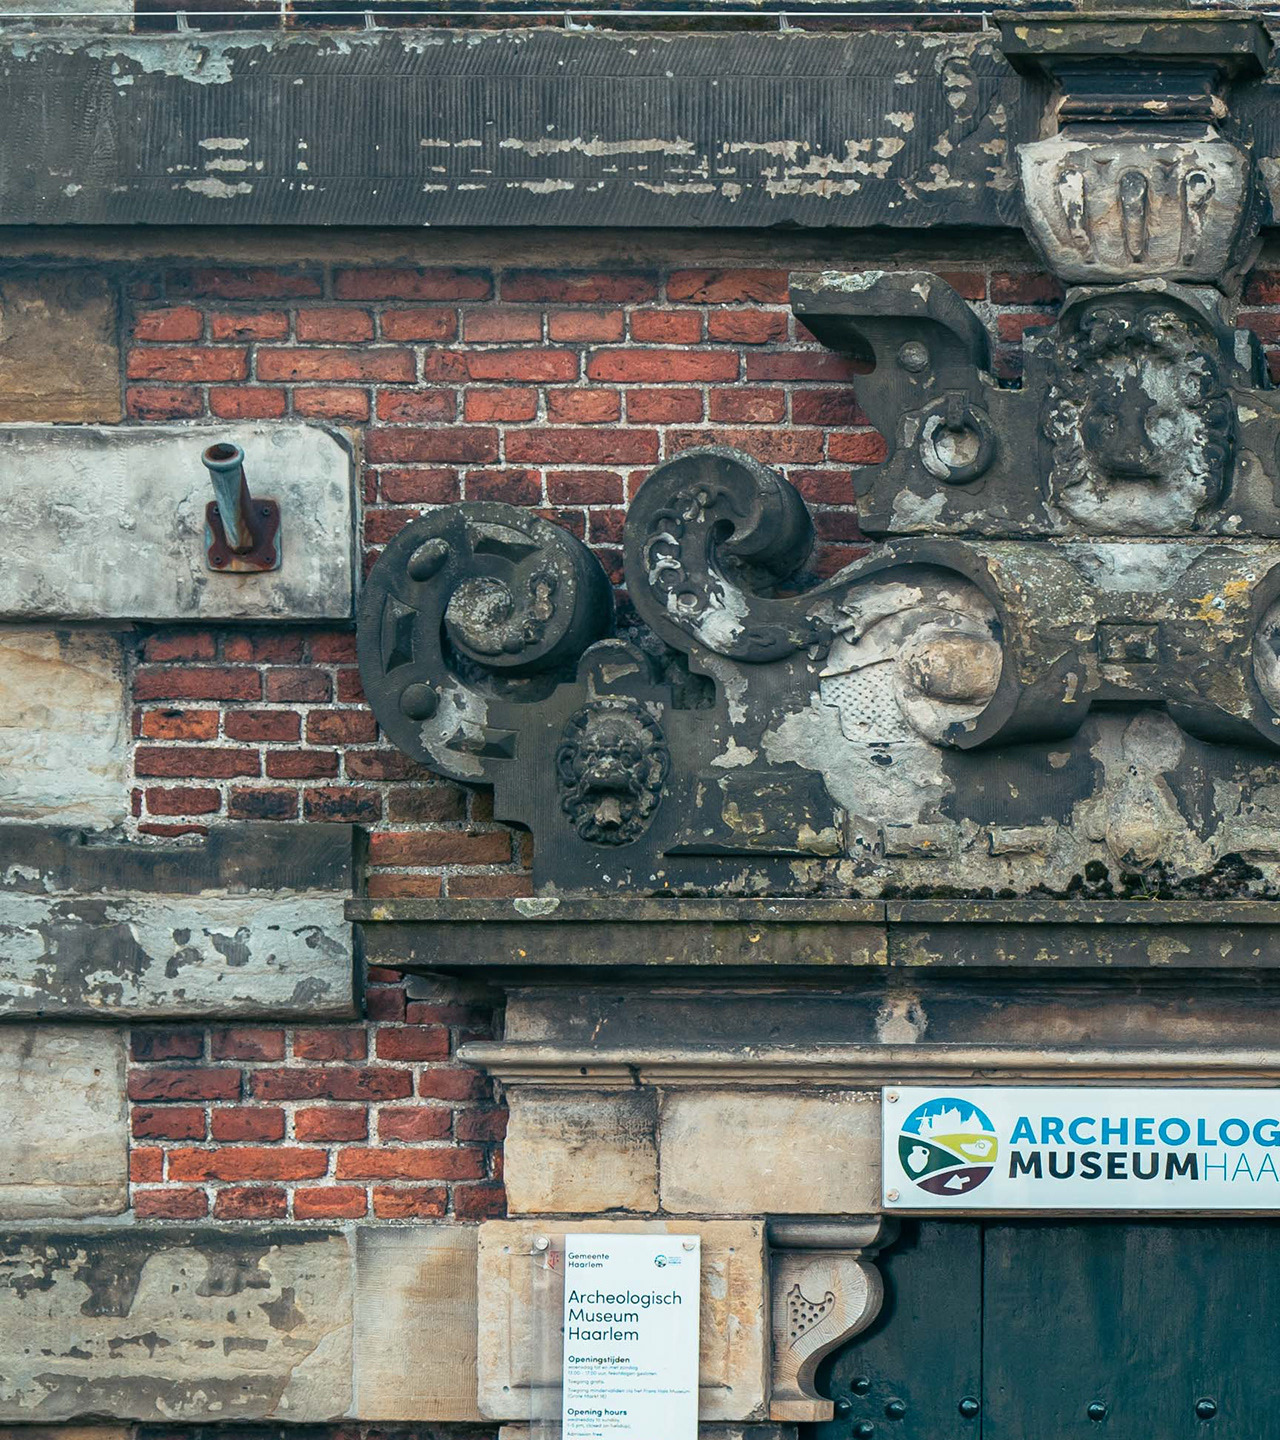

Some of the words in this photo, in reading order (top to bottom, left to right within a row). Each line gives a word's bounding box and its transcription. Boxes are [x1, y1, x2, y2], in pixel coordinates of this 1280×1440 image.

[568, 1252, 610, 1260] Gemeente
[568, 1290, 682, 1308] Archeologisch
[568, 1308, 639, 1322] Museum
[569, 1327, 639, 1340] Haarlem
[568, 1355, 630, 1364] Openingstijden
[567, 1408, 602, 1417] Opening
